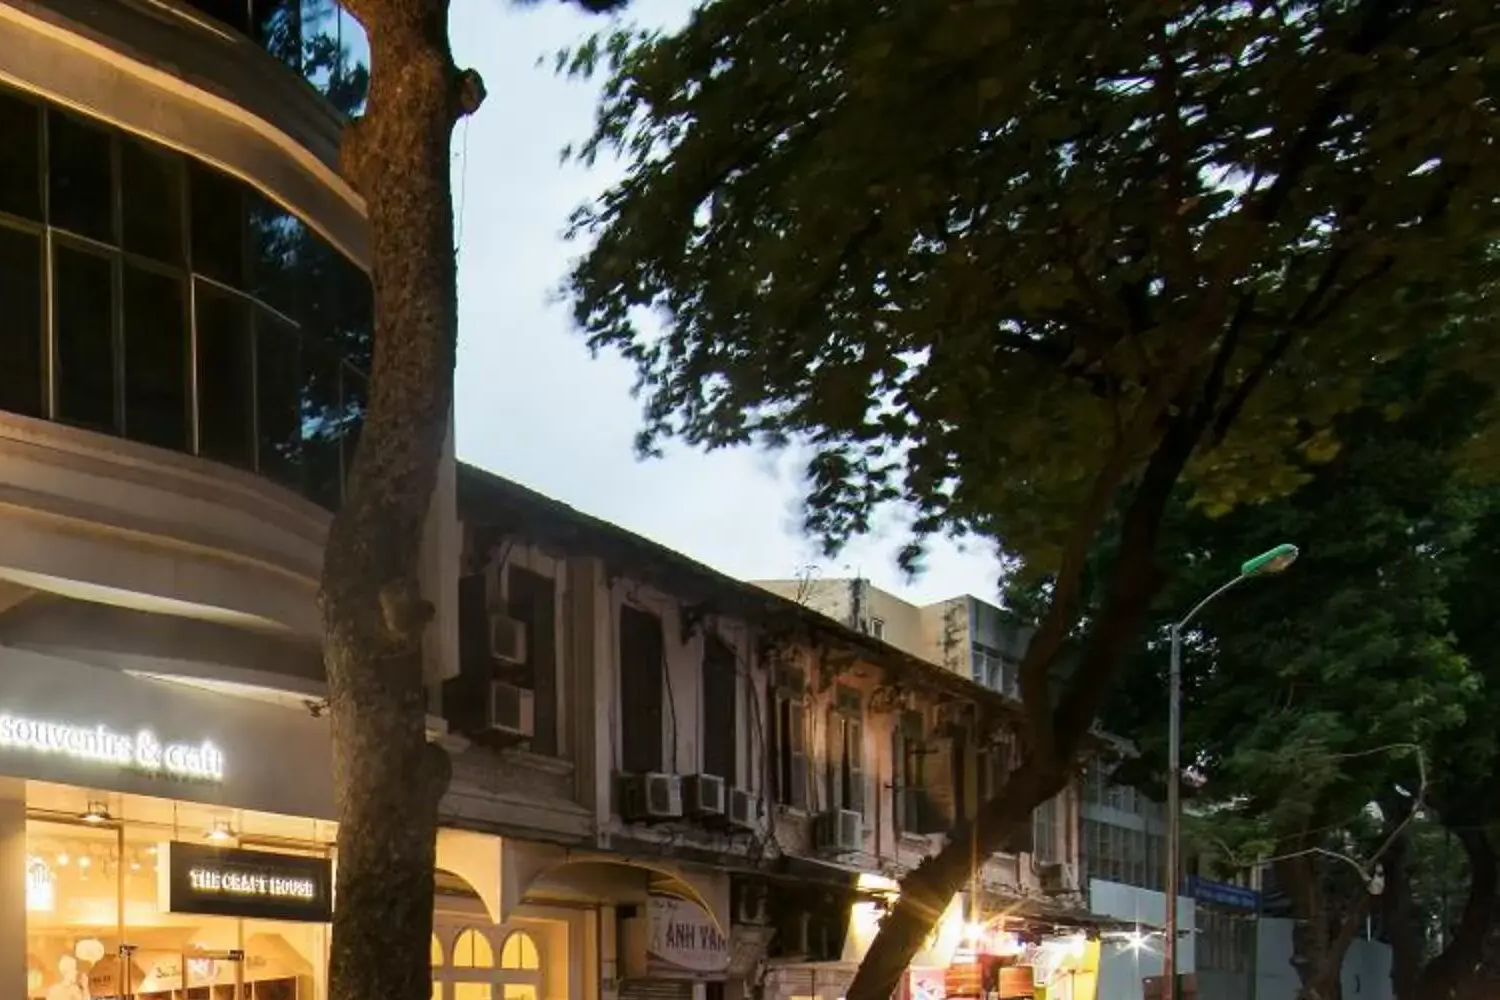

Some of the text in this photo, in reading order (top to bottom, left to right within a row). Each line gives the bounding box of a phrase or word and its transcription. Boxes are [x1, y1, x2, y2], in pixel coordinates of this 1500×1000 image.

[136, 730, 162, 766] &
[164, 738, 225, 781] craft
[189, 868, 313, 898] THE CRAFT HOUSE
[666, 922, 695, 950] ANH
